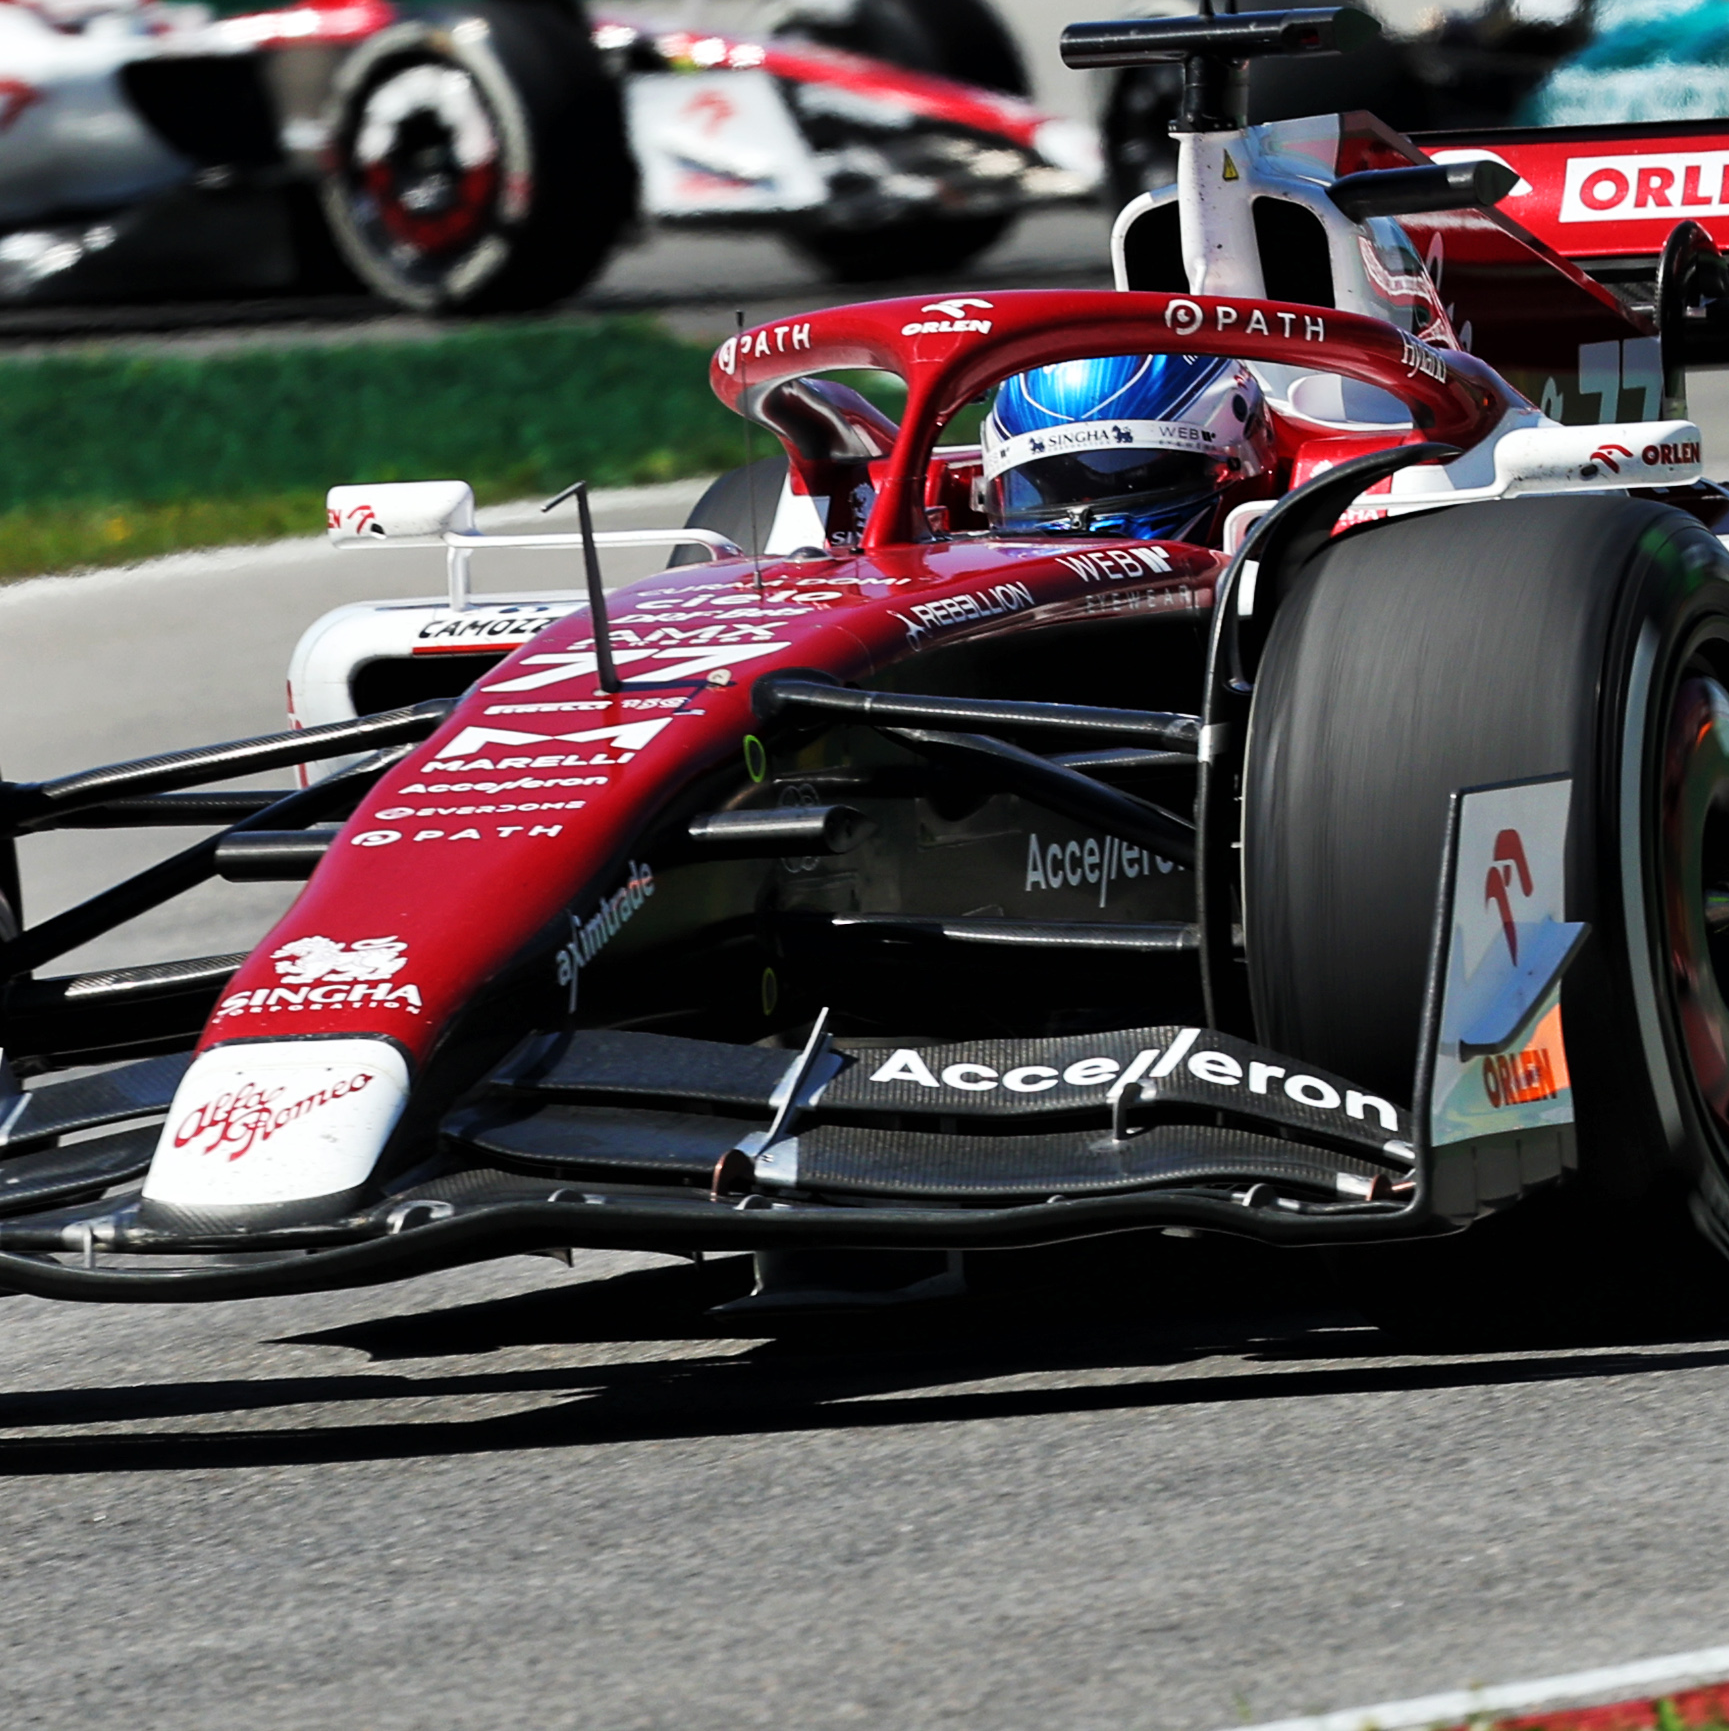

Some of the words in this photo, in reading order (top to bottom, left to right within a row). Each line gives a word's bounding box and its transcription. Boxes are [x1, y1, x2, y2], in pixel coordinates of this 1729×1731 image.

[901, 319, 992, 336] ORLEN
[1216, 305, 1326, 342] PATH
[1578, 334, 1664, 424] 77
[1048, 430, 1109, 446] SINGHA
[1159, 426, 1199, 440] WEB
[1642, 441, 1700, 466] ORLEN
[1057, 549, 1144, 583] WEB
[635, 590, 843, 610] cielo
[911, 581, 1036, 629] REBELLION
[419, 617, 561, 639] CAMOZZ
[480, 641, 792, 692] 77
[421, 751, 634, 774] MARELLI
[398, 776, 608, 796] Accelleron
[413, 824, 563, 842] PATH
[556, 858, 655, 1012] aximtrade
[221, 982, 423, 1010] SINGHA
[870, 1027, 1399, 1132] Accelleron
[1483, 1047, 1558, 1109] ORLEN
[174, 1081, 286, 1155] Alfa
[229, 1073, 375, 1162] Romeo
